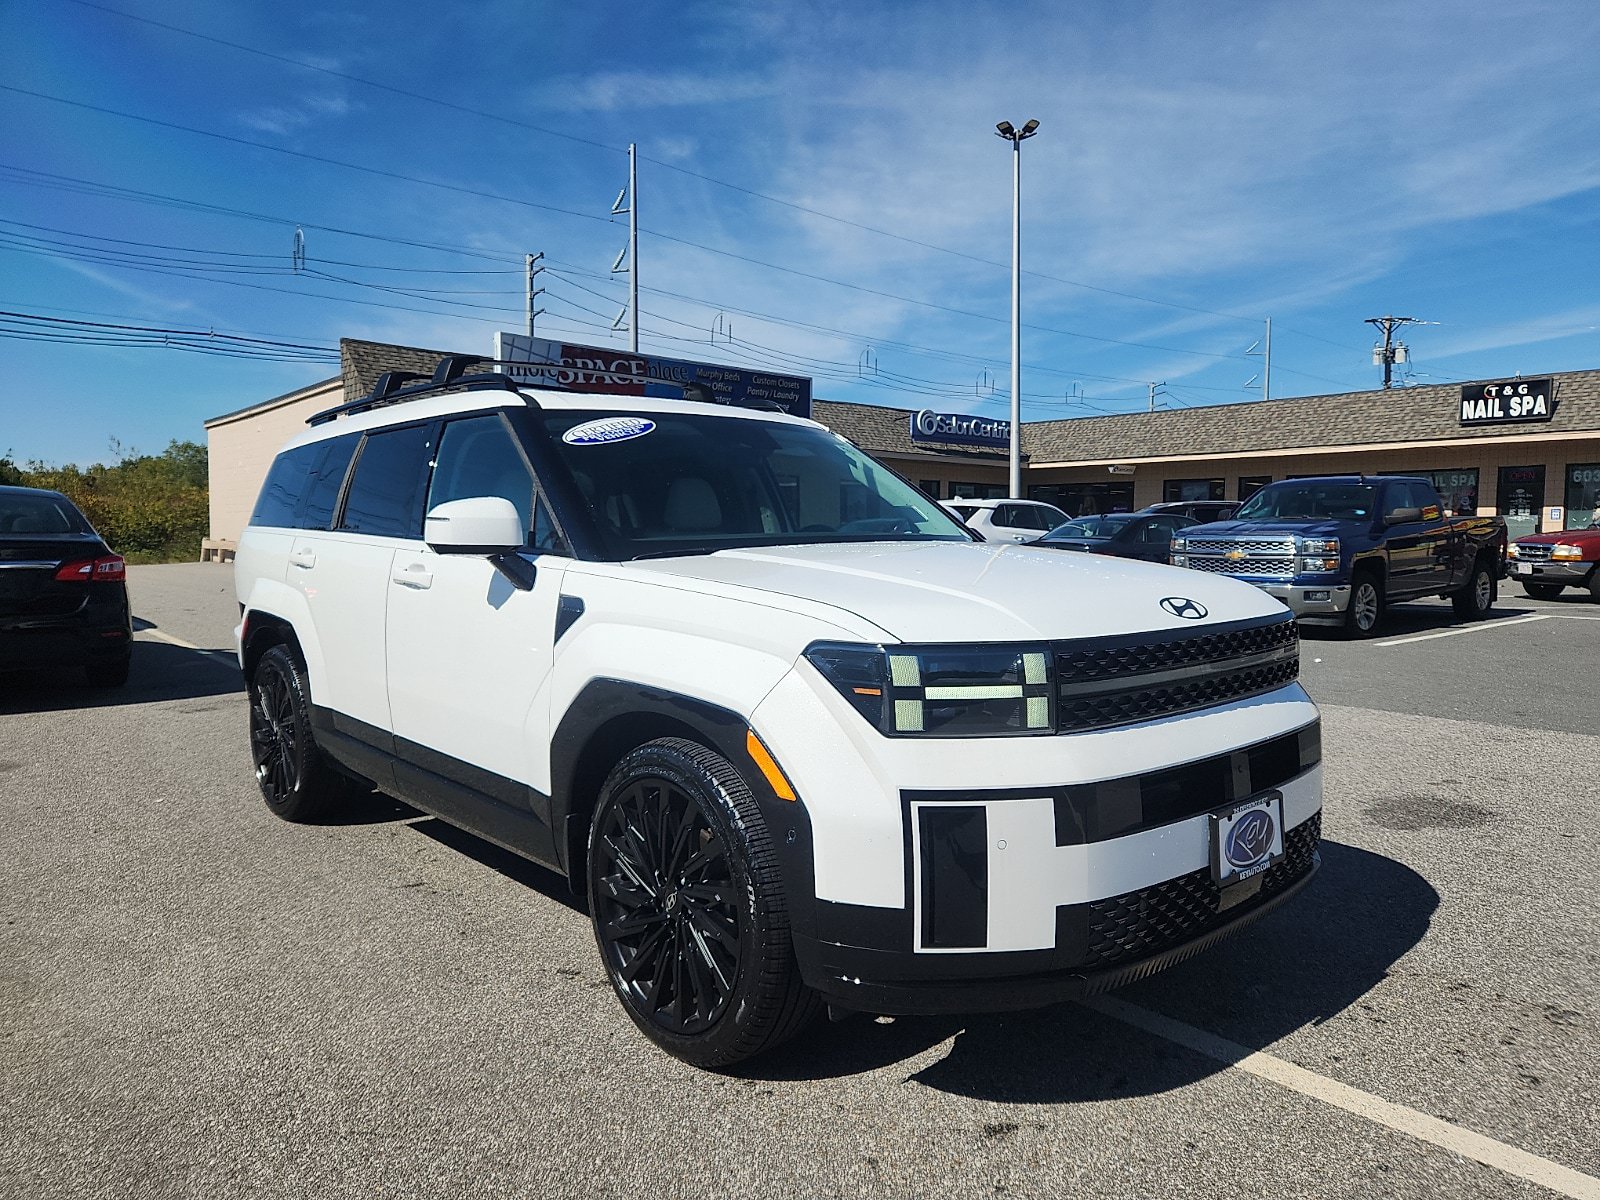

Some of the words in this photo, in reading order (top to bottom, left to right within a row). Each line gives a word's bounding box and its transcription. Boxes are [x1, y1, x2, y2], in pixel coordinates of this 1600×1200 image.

[557, 357, 647, 385] SPACE
[696, 367, 722, 380] Murphy
[724, 372, 741, 382] Beds
[711, 383, 733, 393] Office
[752, 375, 777, 387] Custom
[777, 378, 800, 390] Closets
[747, 386, 770, 399] Pantry
[773, 389, 800, 402] Laundry
[1489, 386, 1500, 397] T
[1503, 385, 1514, 396] &
[1517, 384, 1529, 395] G
[1462, 398, 1504, 420] NAIL
[1509, 395, 1547, 417] SPA
[1450, 474, 1476, 487] SPA
